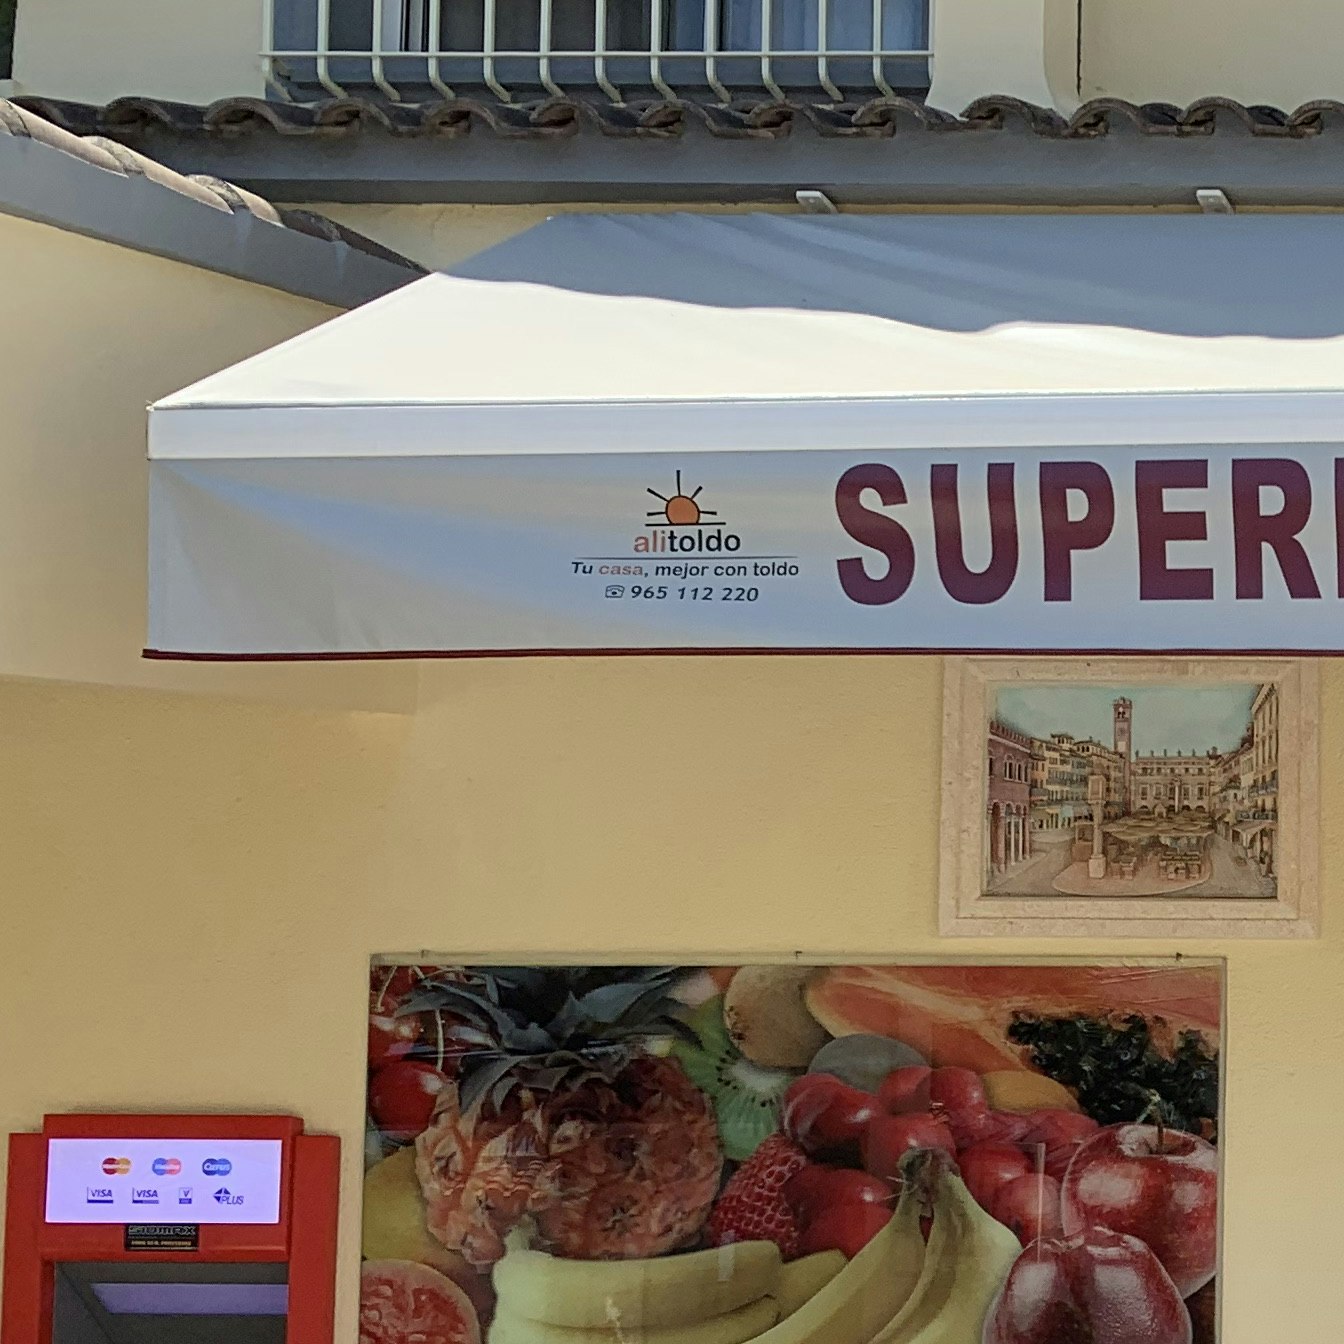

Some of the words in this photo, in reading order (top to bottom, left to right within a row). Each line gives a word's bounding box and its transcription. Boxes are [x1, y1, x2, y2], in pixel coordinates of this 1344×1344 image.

[634, 529, 741, 552] alitoldo
[571, 561, 593, 575] Tu
[598, 565, 649, 578] casa,
[655, 563, 709, 579] mejor
[714, 564, 747, 577] con
[753, 561, 799, 577] toldo
[631, 585, 668, 600] 965
[678, 586, 713, 601] 112
[721, 587, 759, 602] 220
[90, 1188, 113, 1198] VISA
[136, 1189, 159, 1199] VISA
[221, 1195, 244, 1205] PLUS
